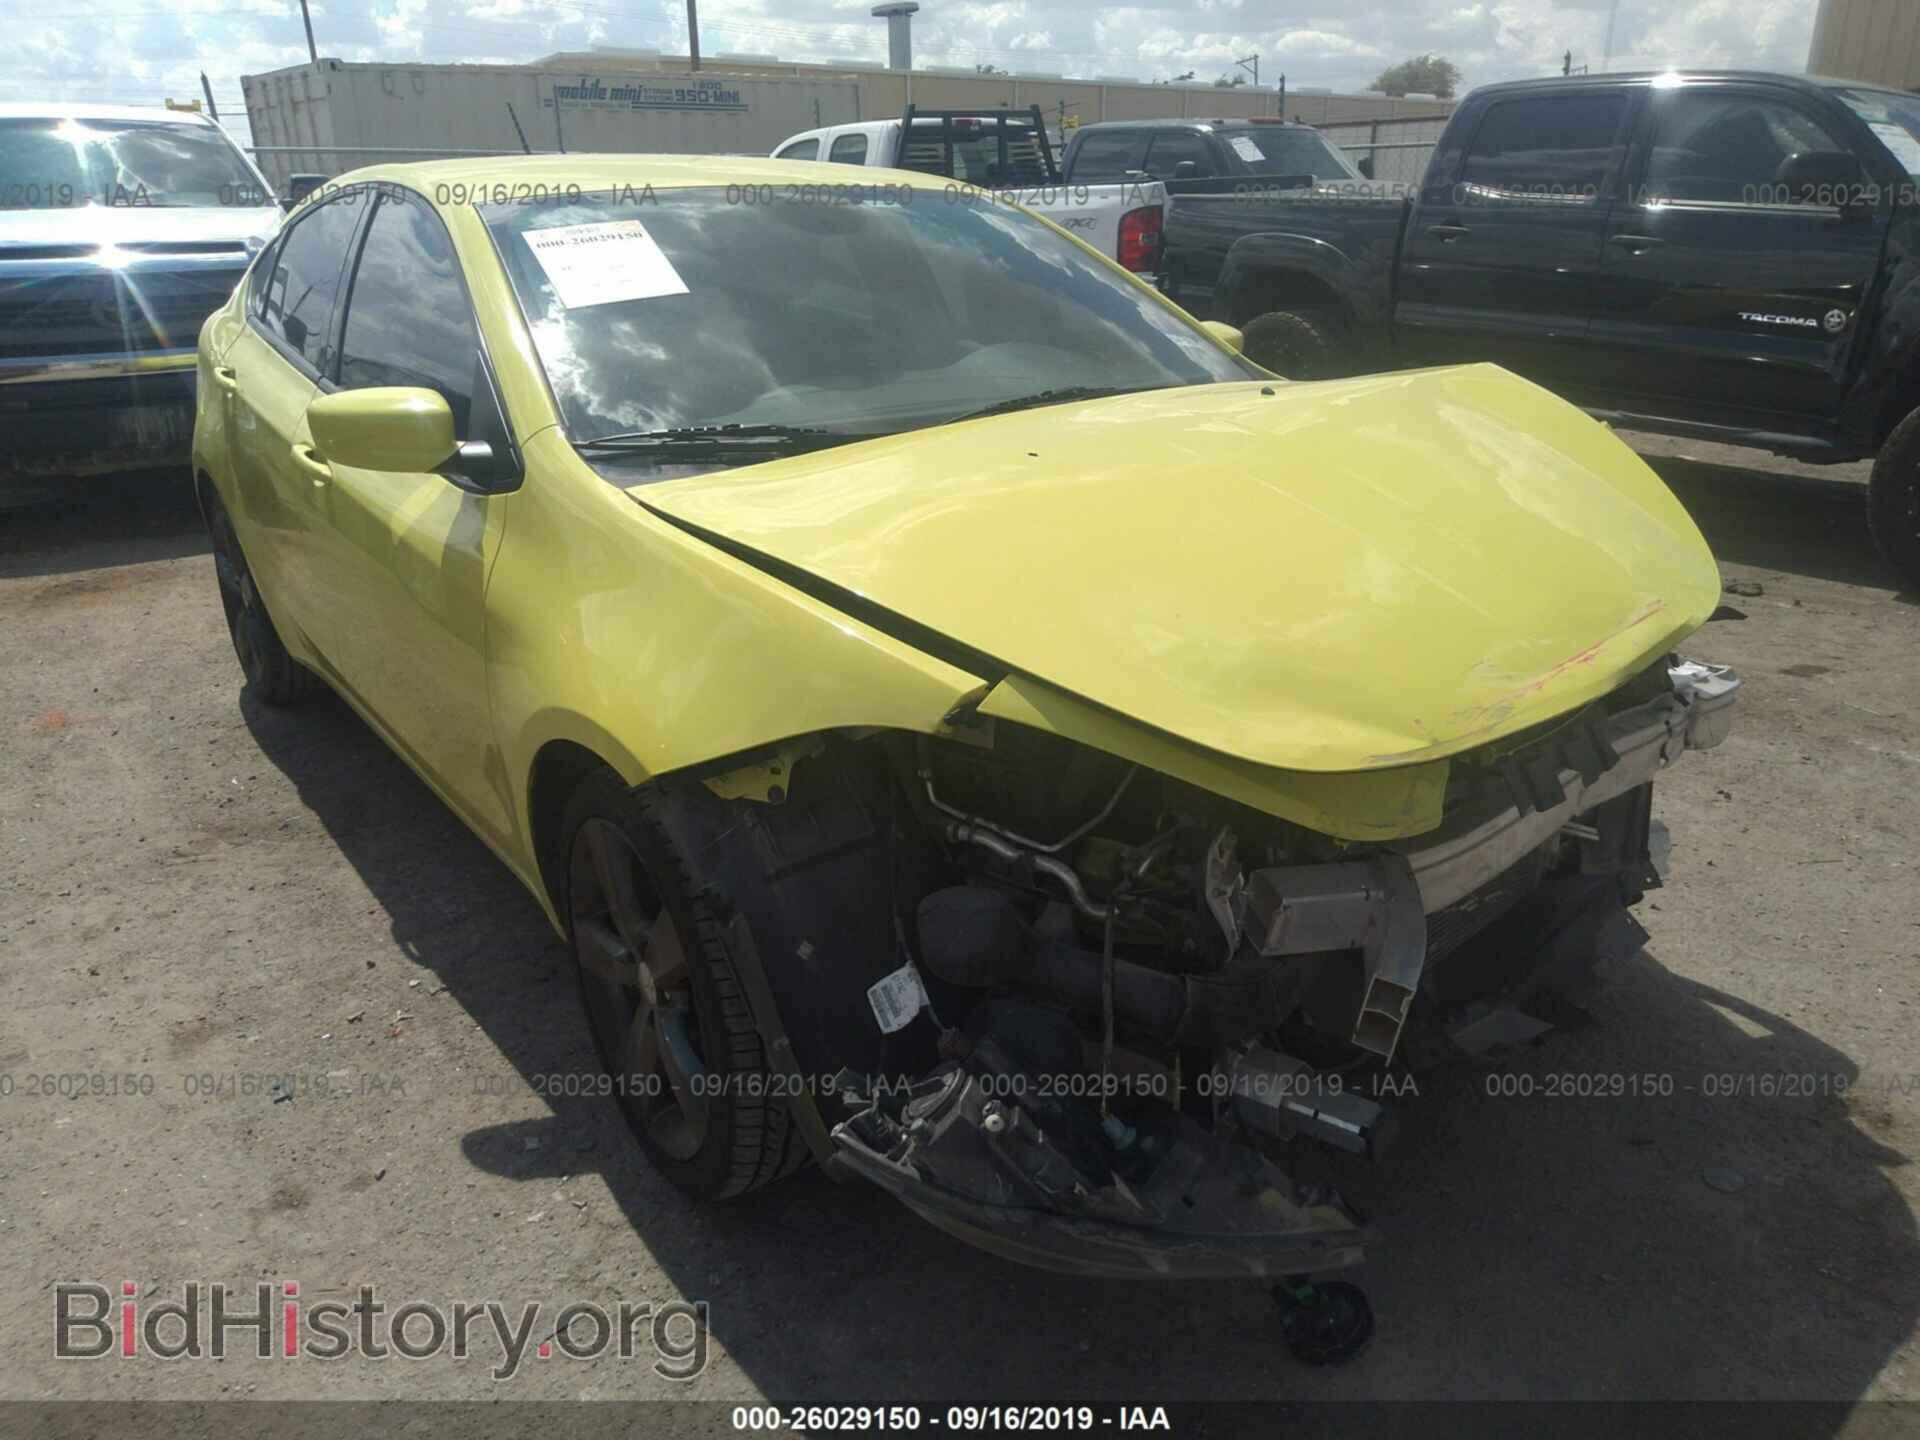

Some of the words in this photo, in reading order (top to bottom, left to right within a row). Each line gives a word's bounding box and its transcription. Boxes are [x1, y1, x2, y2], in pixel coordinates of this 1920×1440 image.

[558, 78, 607, 100] mobile
[610, 84, 643, 100] mini
[1738, 312, 1818, 327] TACOMA
